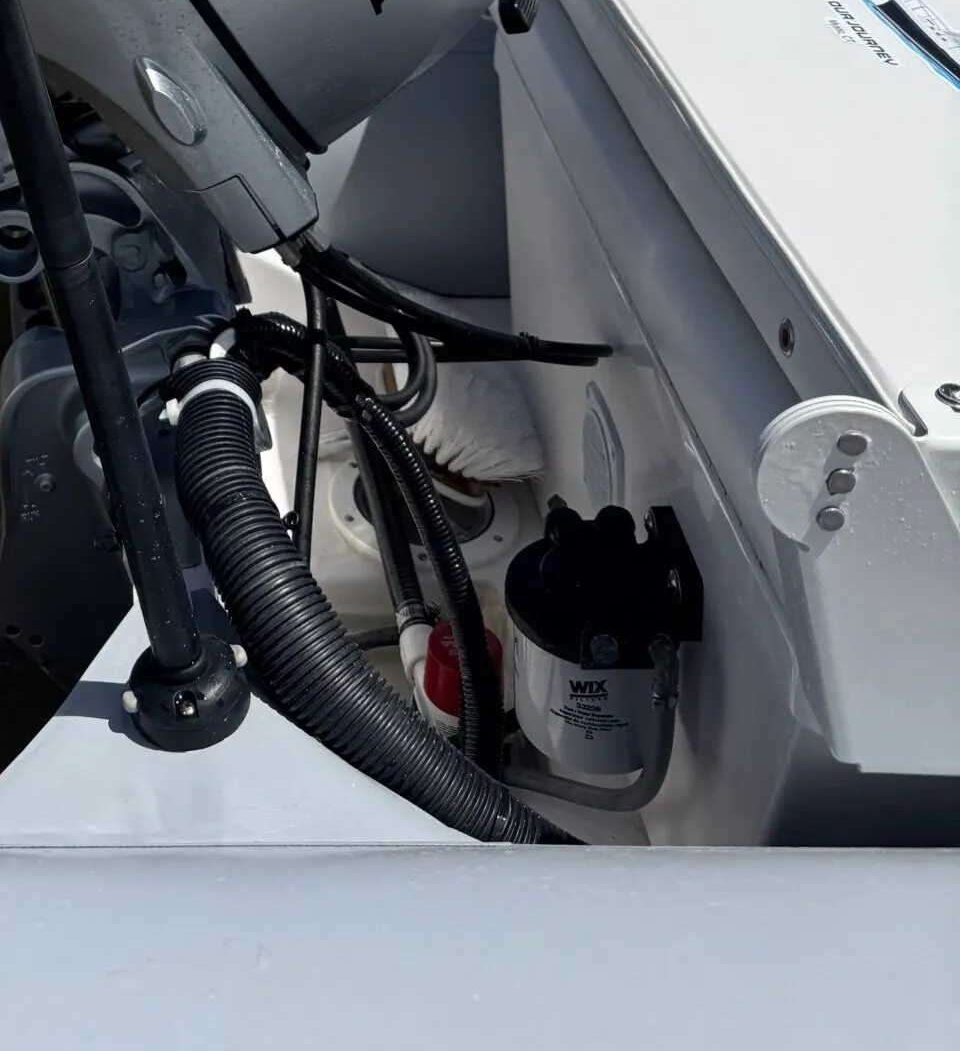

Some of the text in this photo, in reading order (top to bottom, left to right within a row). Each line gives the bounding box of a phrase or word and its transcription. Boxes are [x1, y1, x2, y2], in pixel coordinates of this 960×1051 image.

[827, 0, 900, 67] OUR JOURNEY
[568, 679, 608, 694] WIX
